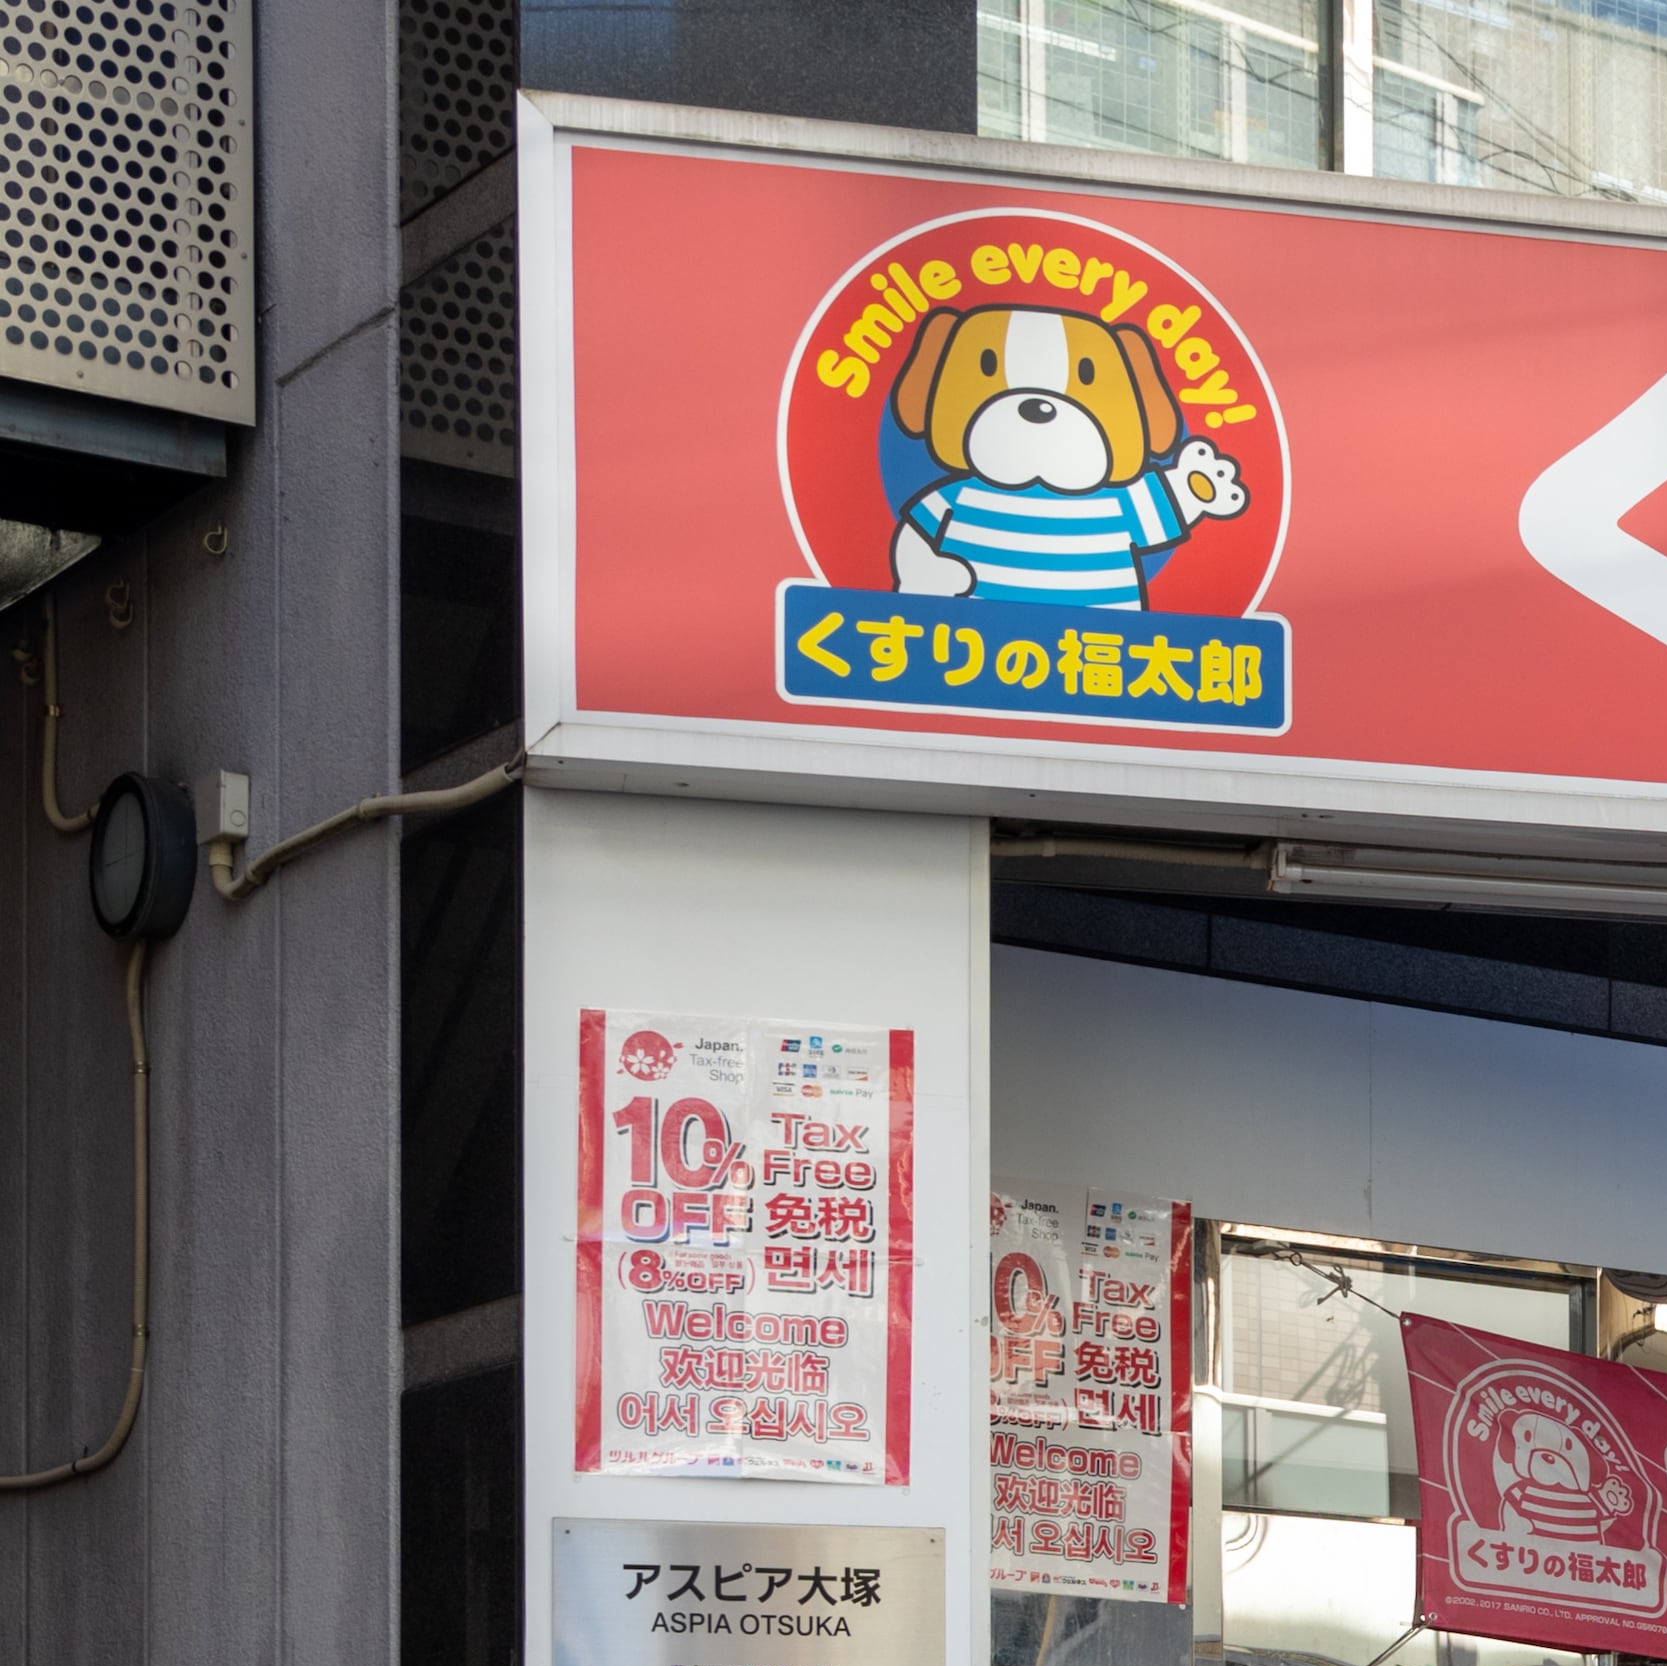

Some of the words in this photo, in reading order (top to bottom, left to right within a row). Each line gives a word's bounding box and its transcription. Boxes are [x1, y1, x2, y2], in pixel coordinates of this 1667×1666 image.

[817, 251, 963, 400] Smile
[968, 240, 1150, 325] every
[1146, 298, 1260, 430] day!
[797, 611, 1264, 707] くすりの福太郎
[689, 1053, 745, 1070] Tax-free
[695, 1037, 744, 1055] Japan.
[709, 1068, 744, 1086] Shop
[612, 1096, 754, 1192] 10%
[770, 1112, 869, 1153] Tax
[762, 1150, 876, 1192] Free
[620, 1188, 752, 1247] OFF
[764, 1194, 875, 1241] 免税
[763, 1245, 875, 1298] 면세
[1078, 1268, 1157, 1309] Tax
[643, 1300, 849, 1347] Welcome
[1071, 1301, 1161, 1341] Free
[660, 1346, 830, 1396] 欢迎光临
[1074, 1341, 1162, 1388] 免税
[617, 1393, 698, 1437] 어서
[708, 1397, 871, 1444] 오십시오
[1076, 1388, 1162, 1437] 면세
[1467, 1386, 1517, 1442] Smile
[1515, 1385, 1581, 1425] every
[995, 1476, 1125, 1522] 欢迎光临
[1030, 1518, 1159, 1565] 오십시오
[1467, 1538, 1648, 1591] くすりの福太郎
[621, 1562, 882, 1609] アスピア大塚
[651, 1612, 733, 1635] ASPIA
[739, 1613, 852, 1638] OTSUKA
[1503, 1602, 1537, 1615] SANRIO
[1575, 1612, 1621, 1627] APPROVAL
